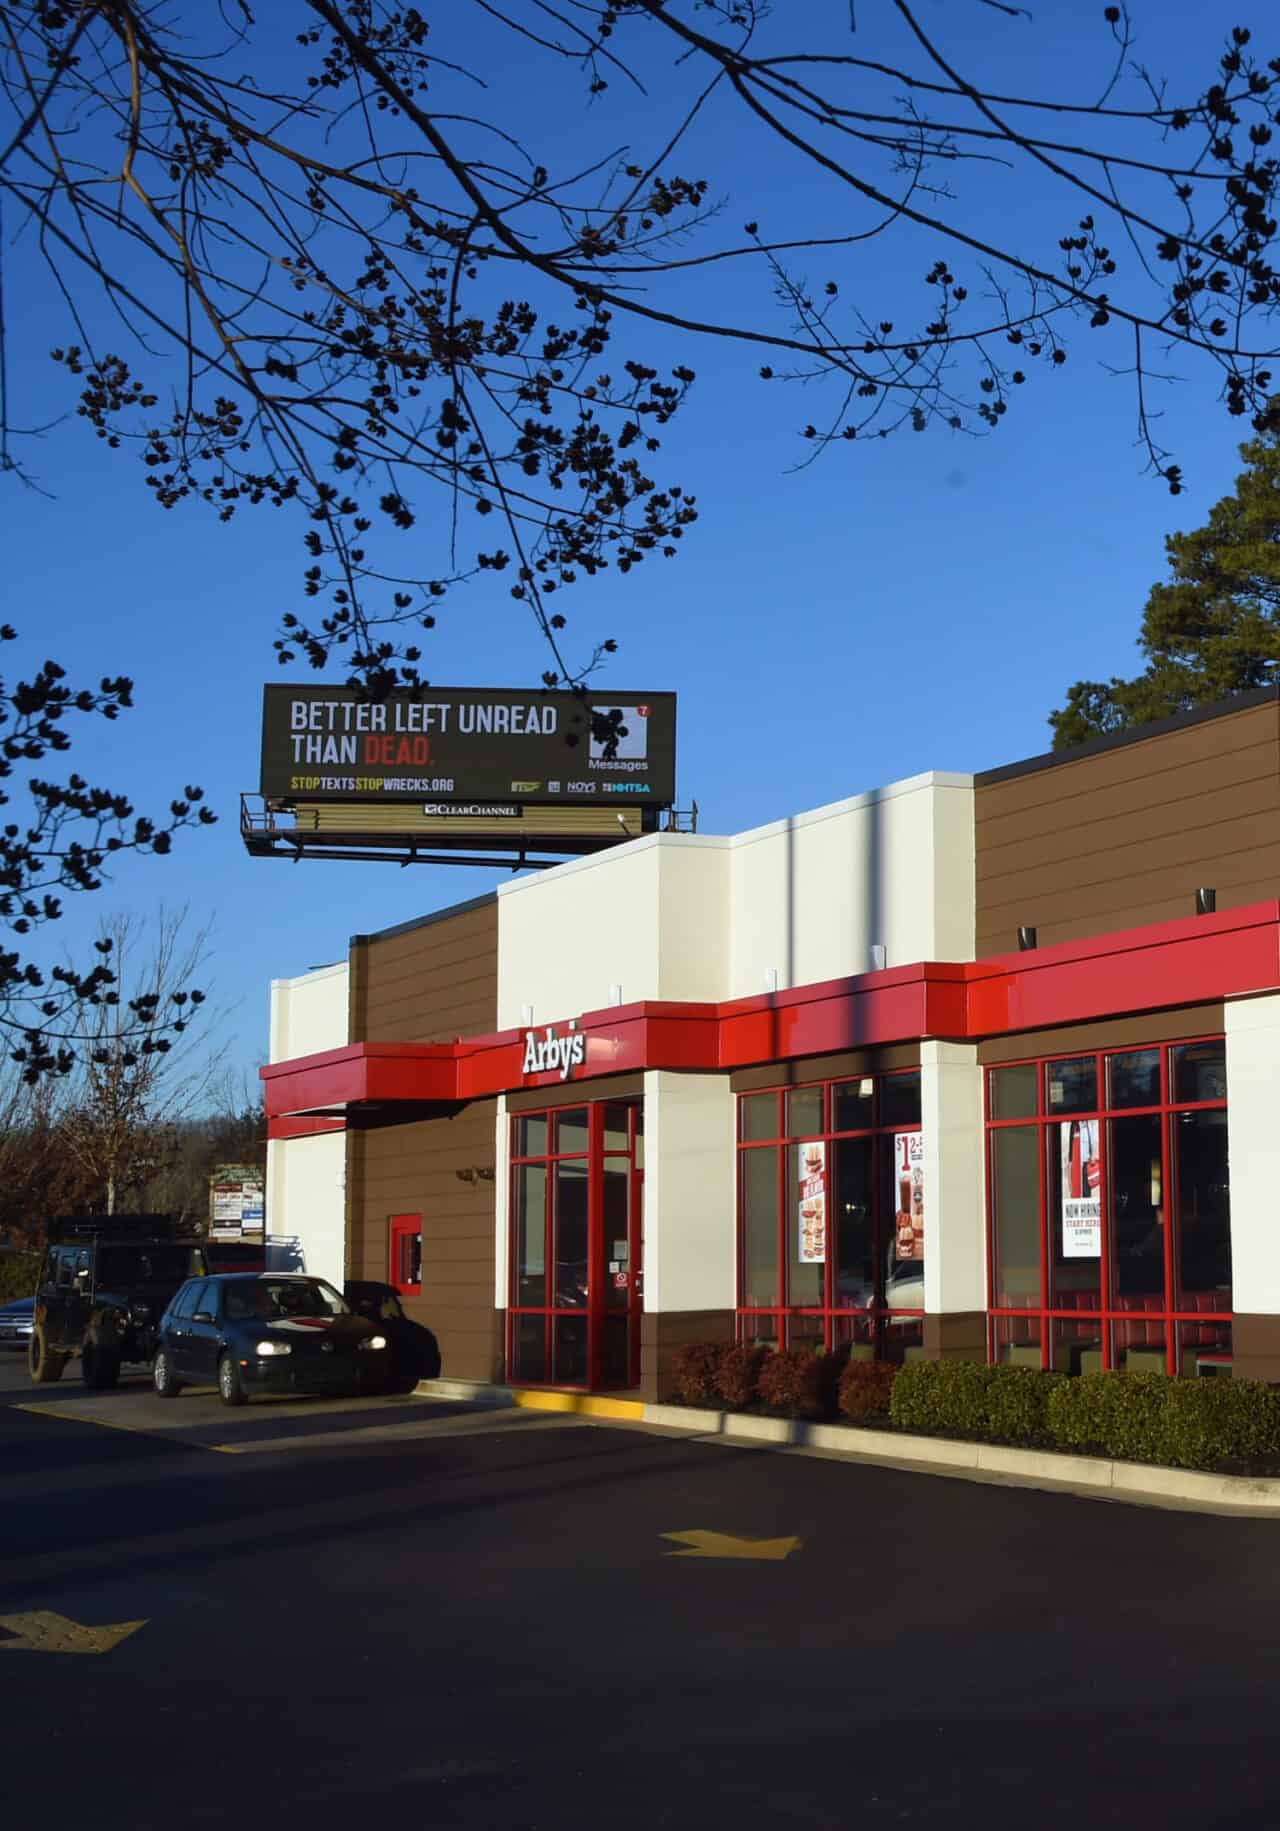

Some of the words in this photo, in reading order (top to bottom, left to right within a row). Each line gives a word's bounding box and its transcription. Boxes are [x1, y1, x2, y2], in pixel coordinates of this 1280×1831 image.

[290, 701, 387, 731] BETTER
[395, 703, 451, 733] LEFT
[458, 704, 558, 734] UNREAD
[290, 734, 357, 764] THAN
[365, 735, 436, 767] DEAD.
[588, 759, 648, 772] Messages
[291, 776, 454, 792] STOPTEXTSSTOPWRECKS.ORG
[522, 1020, 584, 1080] Arby's
